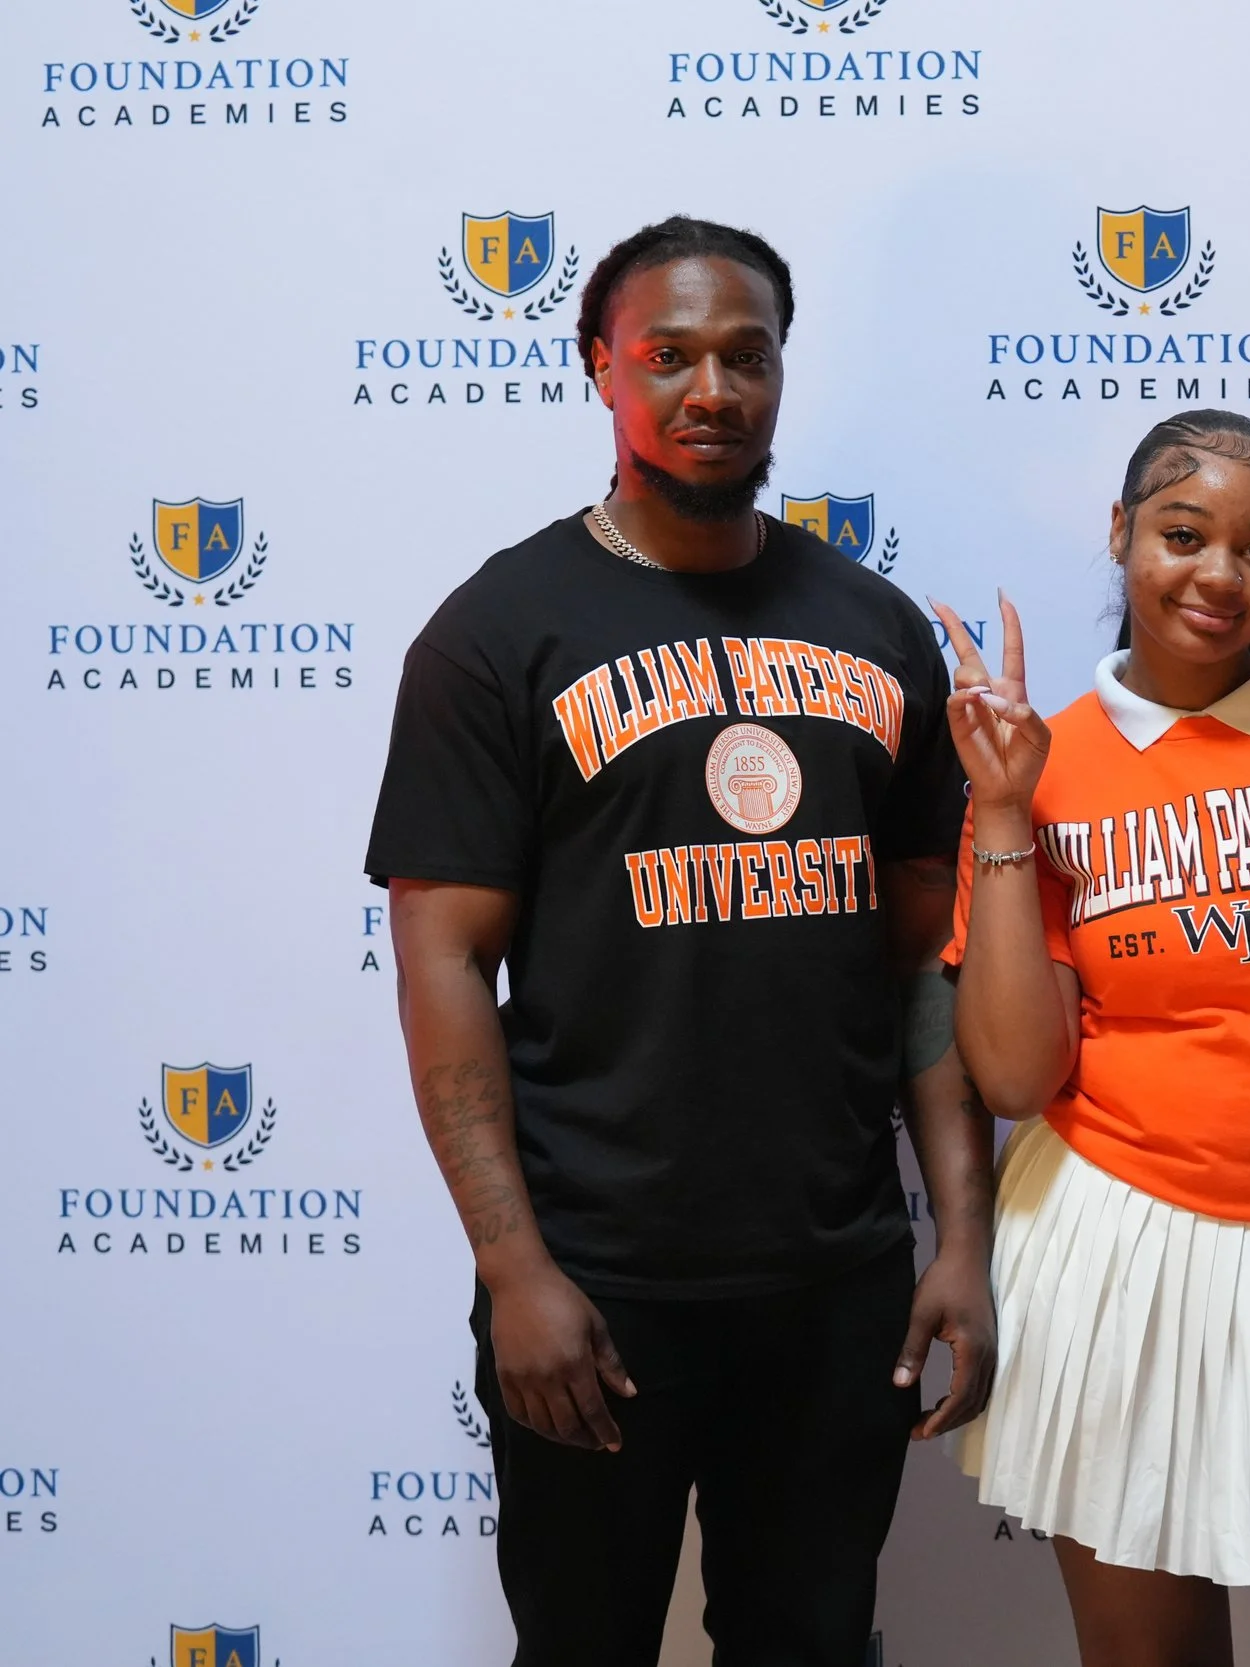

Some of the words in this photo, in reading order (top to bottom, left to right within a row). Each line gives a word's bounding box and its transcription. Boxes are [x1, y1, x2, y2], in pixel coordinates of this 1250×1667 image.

[43, 57, 349, 93] FOUNDATION
[670, 51, 980, 82] FOUNDATION
[42, 101, 347, 127] ACADEMIES
[667, 94, 979, 118] ACADEMIES
[355, 338, 577, 369] FOUNDAT
[354, 381, 590, 404] ACADEMI
[49, 624, 352, 654] FOUNDATION
[48, 667, 352, 689] ACADEMIES
[552, 638, 727, 783] WILLIAM
[721, 636, 905, 764] PATERSON
[740, 727, 787, 754] UNIVERSITY
[734, 755, 766, 773] 1855
[743, 819, 775, 831] WAYNE
[1036, 794, 1211, 930] WILLIAM
[1108, 931, 1166, 960] EST.
[60, 1189, 359, 1218] FOUNDATION
[58, 1232, 360, 1254] ACADEMIES
